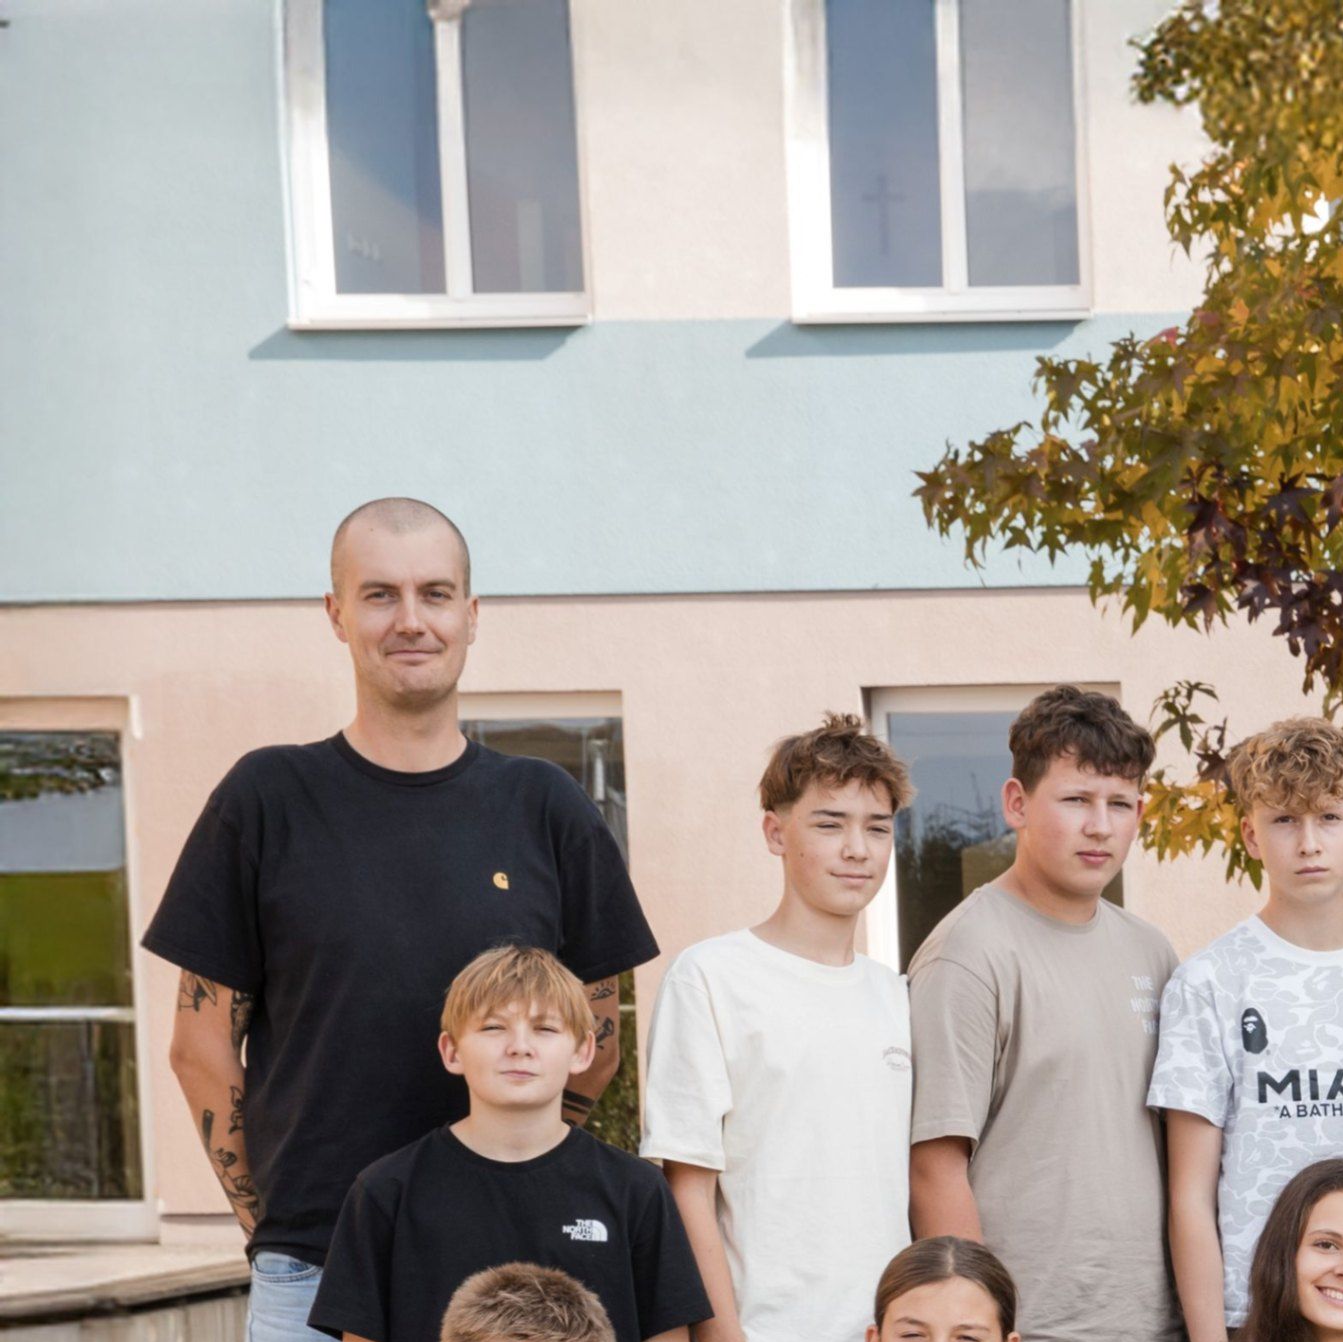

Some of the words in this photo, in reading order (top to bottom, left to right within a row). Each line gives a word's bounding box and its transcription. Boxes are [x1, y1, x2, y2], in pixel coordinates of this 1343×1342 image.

[575, 1219, 592, 1227] THE
[562, 1225, 592, 1234] NORTH
[570, 1232, 592, 1241] FACE
